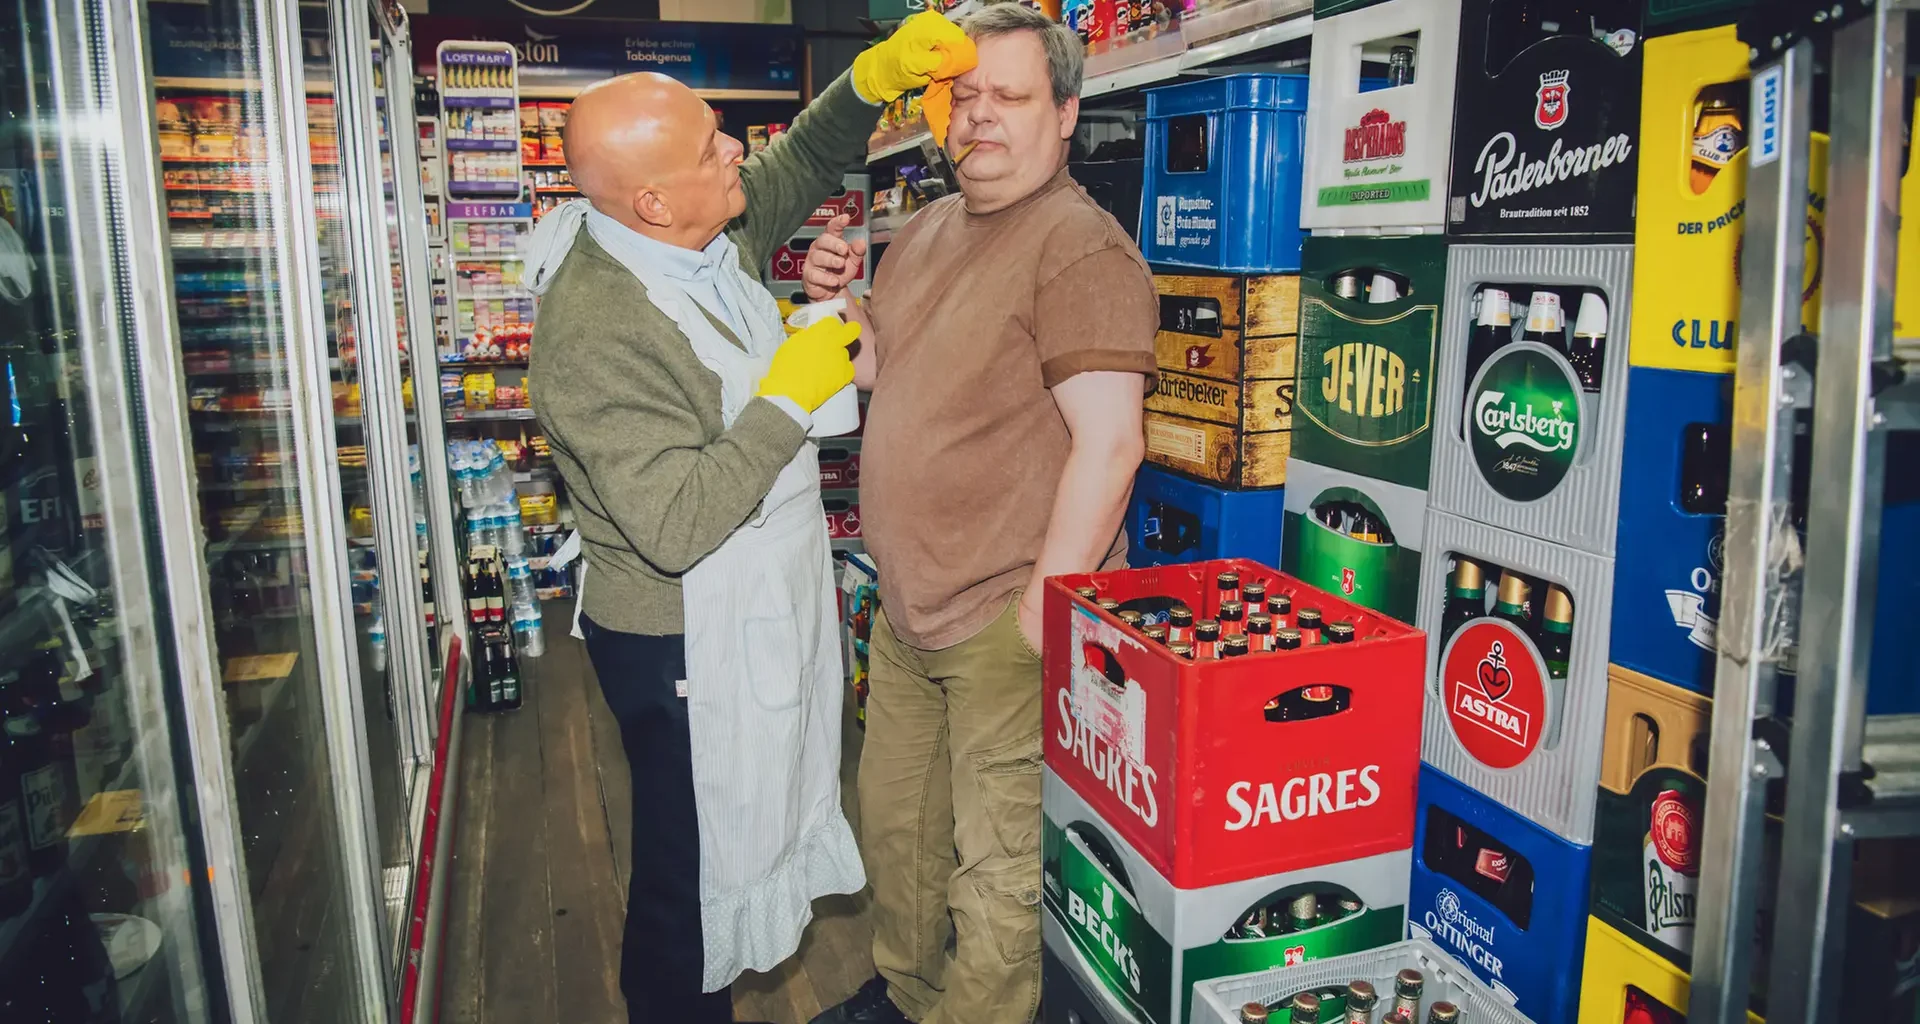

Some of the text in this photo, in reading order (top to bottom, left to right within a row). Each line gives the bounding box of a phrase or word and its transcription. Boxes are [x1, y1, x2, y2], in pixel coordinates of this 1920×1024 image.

[516, 39, 559, 63] ston
[625, 37, 695, 49] Erlebe echten
[445, 53, 507, 63] LOST MARY
[625, 50, 692, 64] Tabakgenuss
[1343, 121, 1406, 162] DESPERADOS
[1470, 131, 1633, 208] Paderborner
[1350, 188, 1391, 201] IMPORTED
[464, 205, 516, 216] ELFBAR
[812, 208, 835, 217] TRA
[1500, 207, 1552, 219] Brautradition
[1570, 205, 1590, 217] 1852
[1677, 222, 1703, 235] DER
[1156, 371, 1228, 407] törtebeker
[1321, 342, 1406, 418] JEVER
[1475, 390, 1575, 451] Carlsberg
[820, 472, 838, 480] TRA
[1460, 693, 1521, 737] ASTRA
[1056, 687, 1158, 829] SAGRES
[1224, 764, 1381, 832] SAGRES
[1068, 887, 1141, 995] BECK'S
